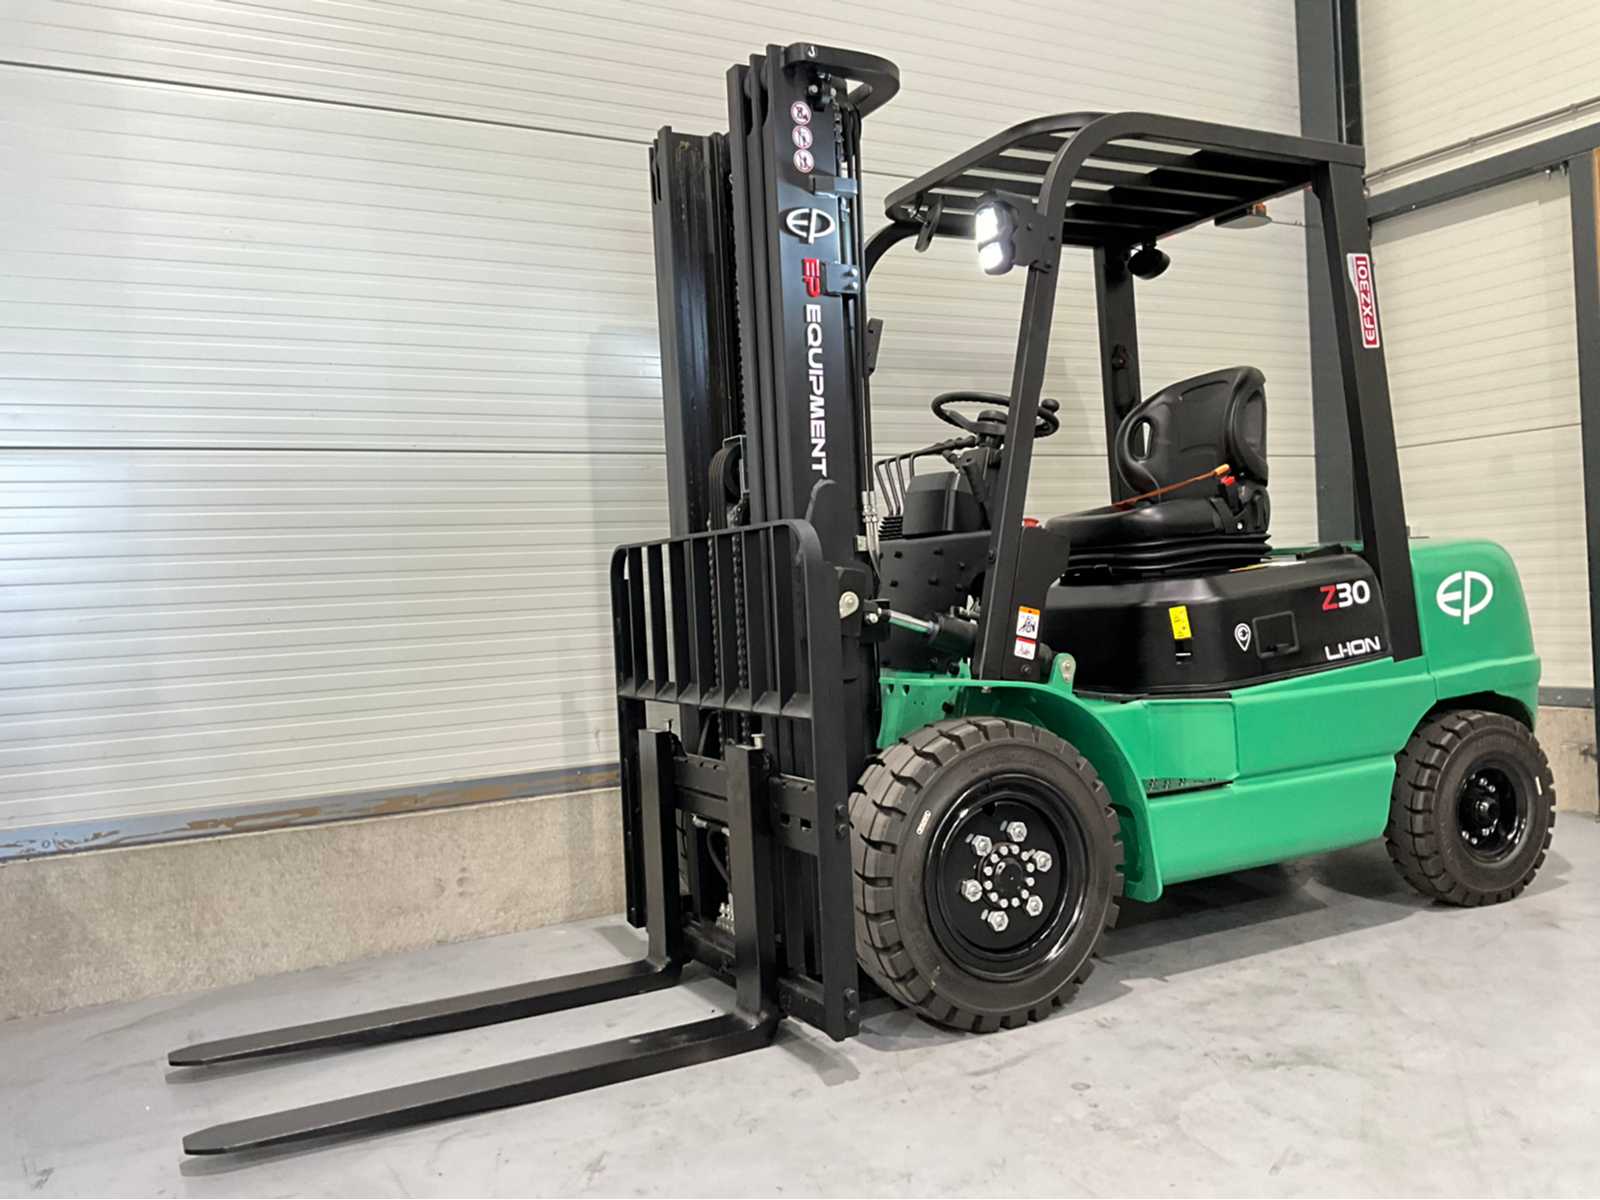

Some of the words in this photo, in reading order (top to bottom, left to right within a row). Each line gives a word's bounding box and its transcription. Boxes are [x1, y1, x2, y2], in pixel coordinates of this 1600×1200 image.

[803, 258, 820, 297] EP
[805, 303, 827, 477] EQUIPMENT
[1320, 580, 1371, 611] Z30
[1436, 570, 1494, 625] EP
